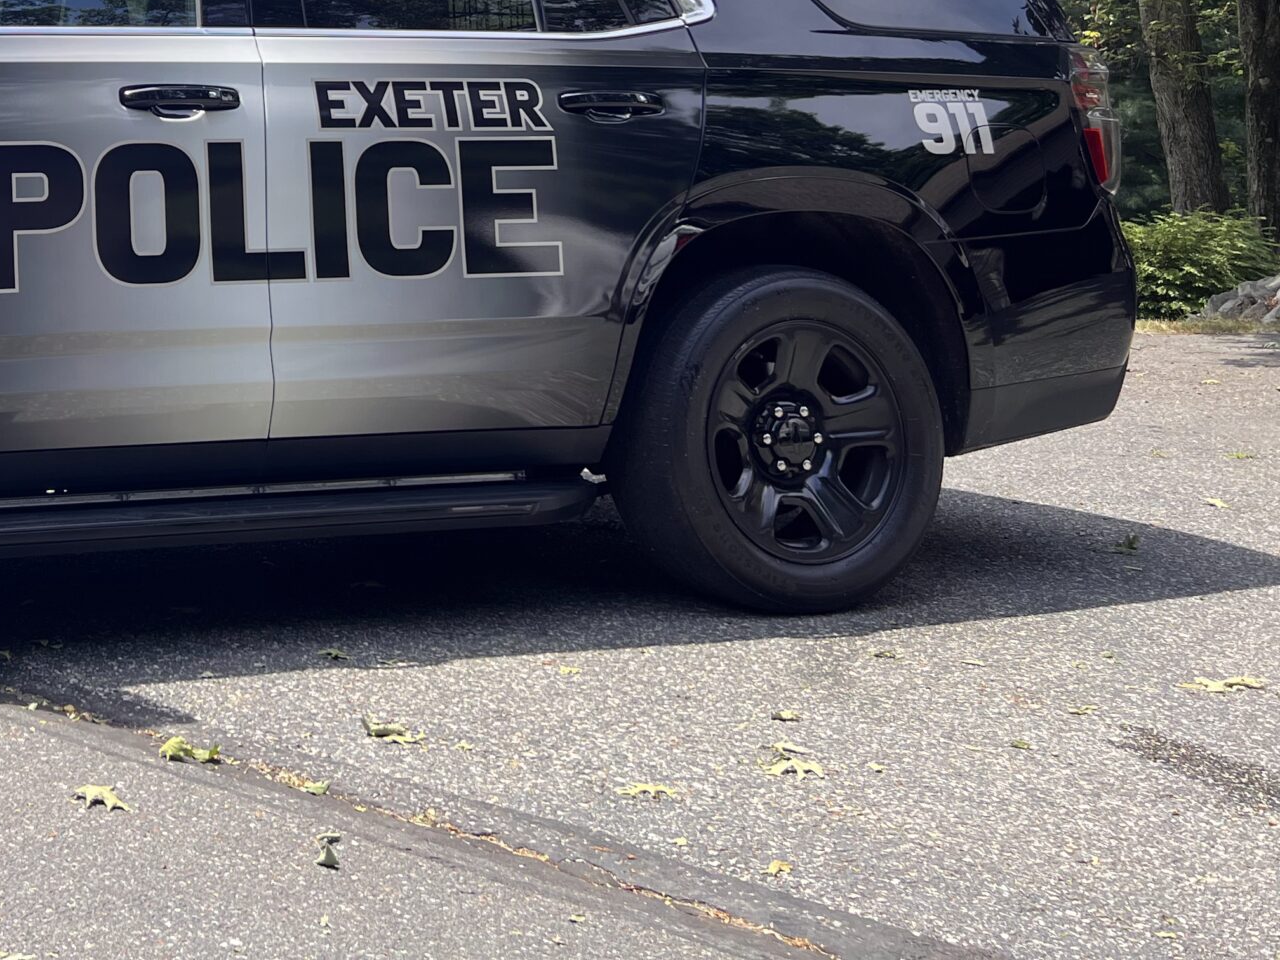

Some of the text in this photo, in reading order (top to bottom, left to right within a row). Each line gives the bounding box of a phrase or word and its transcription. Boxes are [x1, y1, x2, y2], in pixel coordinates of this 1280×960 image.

[314, 78, 554, 131] EXETER
[907, 89, 980, 103] EMERGENCY
[913, 102, 995, 155] 911
